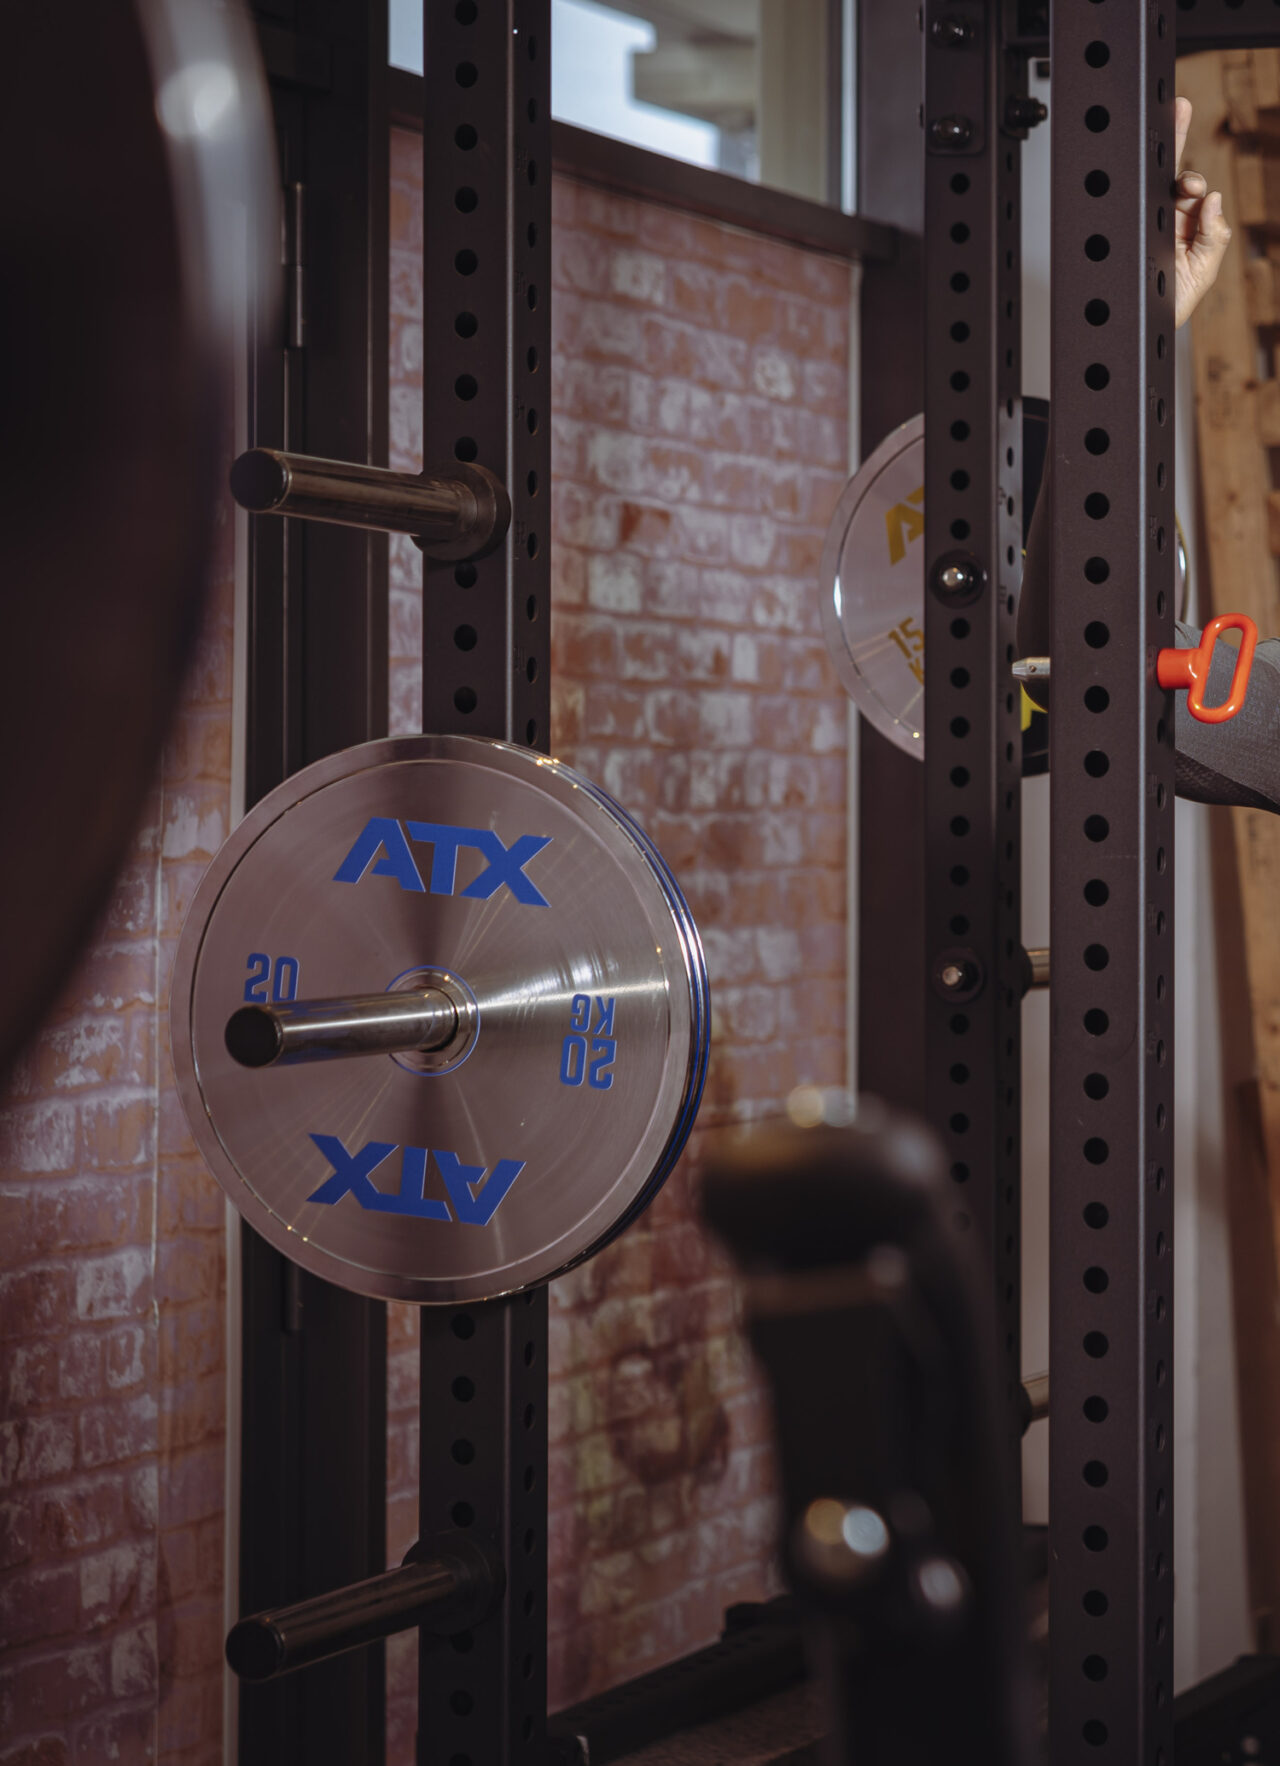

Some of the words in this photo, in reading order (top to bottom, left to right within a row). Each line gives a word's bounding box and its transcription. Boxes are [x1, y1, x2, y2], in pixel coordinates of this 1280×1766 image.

[888, 616, 925, 659] 15
[333, 817, 554, 908] ATX
[244, 952, 300, 1002] 20
[571, 993, 616, 1035] KG
[558, 1036, 617, 1091] 20
[306, 1132, 527, 1227] ATX
